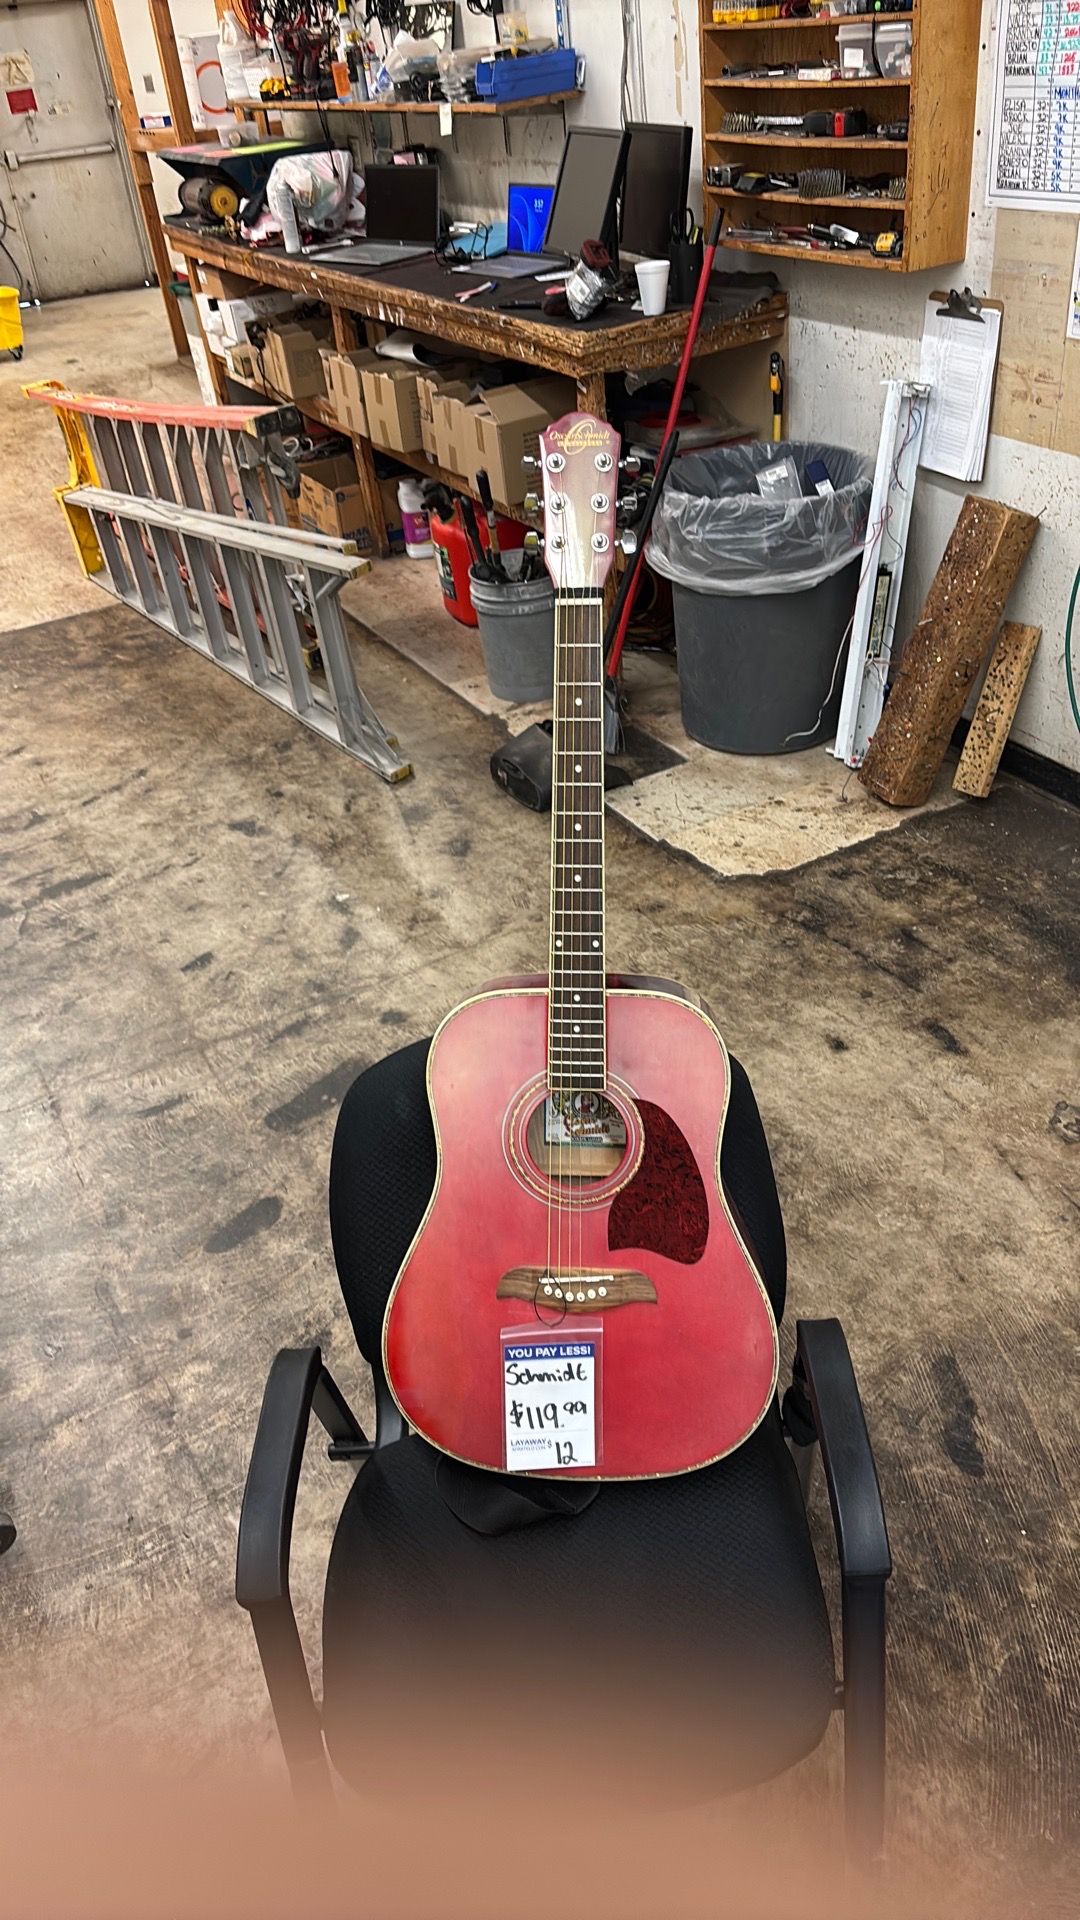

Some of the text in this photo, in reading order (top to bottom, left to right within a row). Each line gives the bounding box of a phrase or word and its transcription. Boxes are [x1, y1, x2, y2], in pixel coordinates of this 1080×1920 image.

[508, 1346, 591, 1359] YOU PAY LESS!
[506, 1363, 588, 1386] Schmidt
[511, 1439, 546, 1447] LAYAWAY
[555, 1441, 578, 1465] 12
